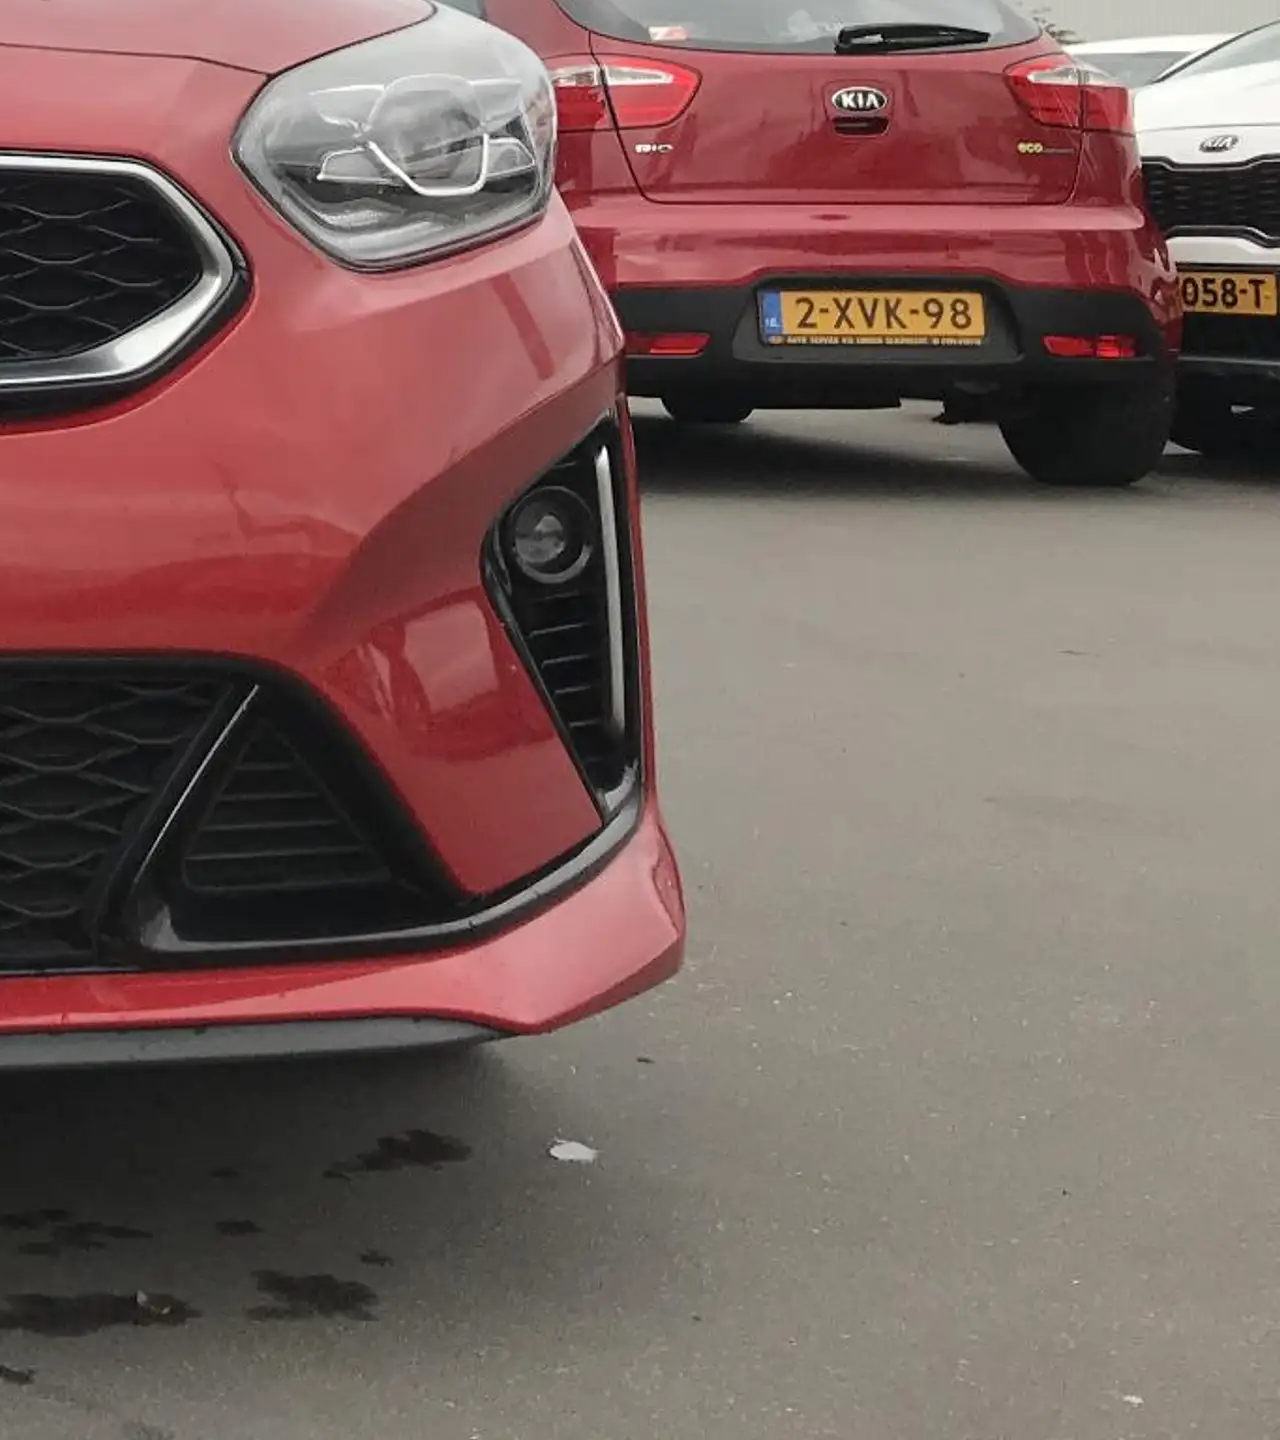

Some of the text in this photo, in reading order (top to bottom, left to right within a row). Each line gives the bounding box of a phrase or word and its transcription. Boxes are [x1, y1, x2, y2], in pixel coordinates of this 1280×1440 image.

[841, 91, 880, 109] KIA
[1181, 276, 1266, 310] 058-T
[794, 296, 973, 330] 2-XVK-98
